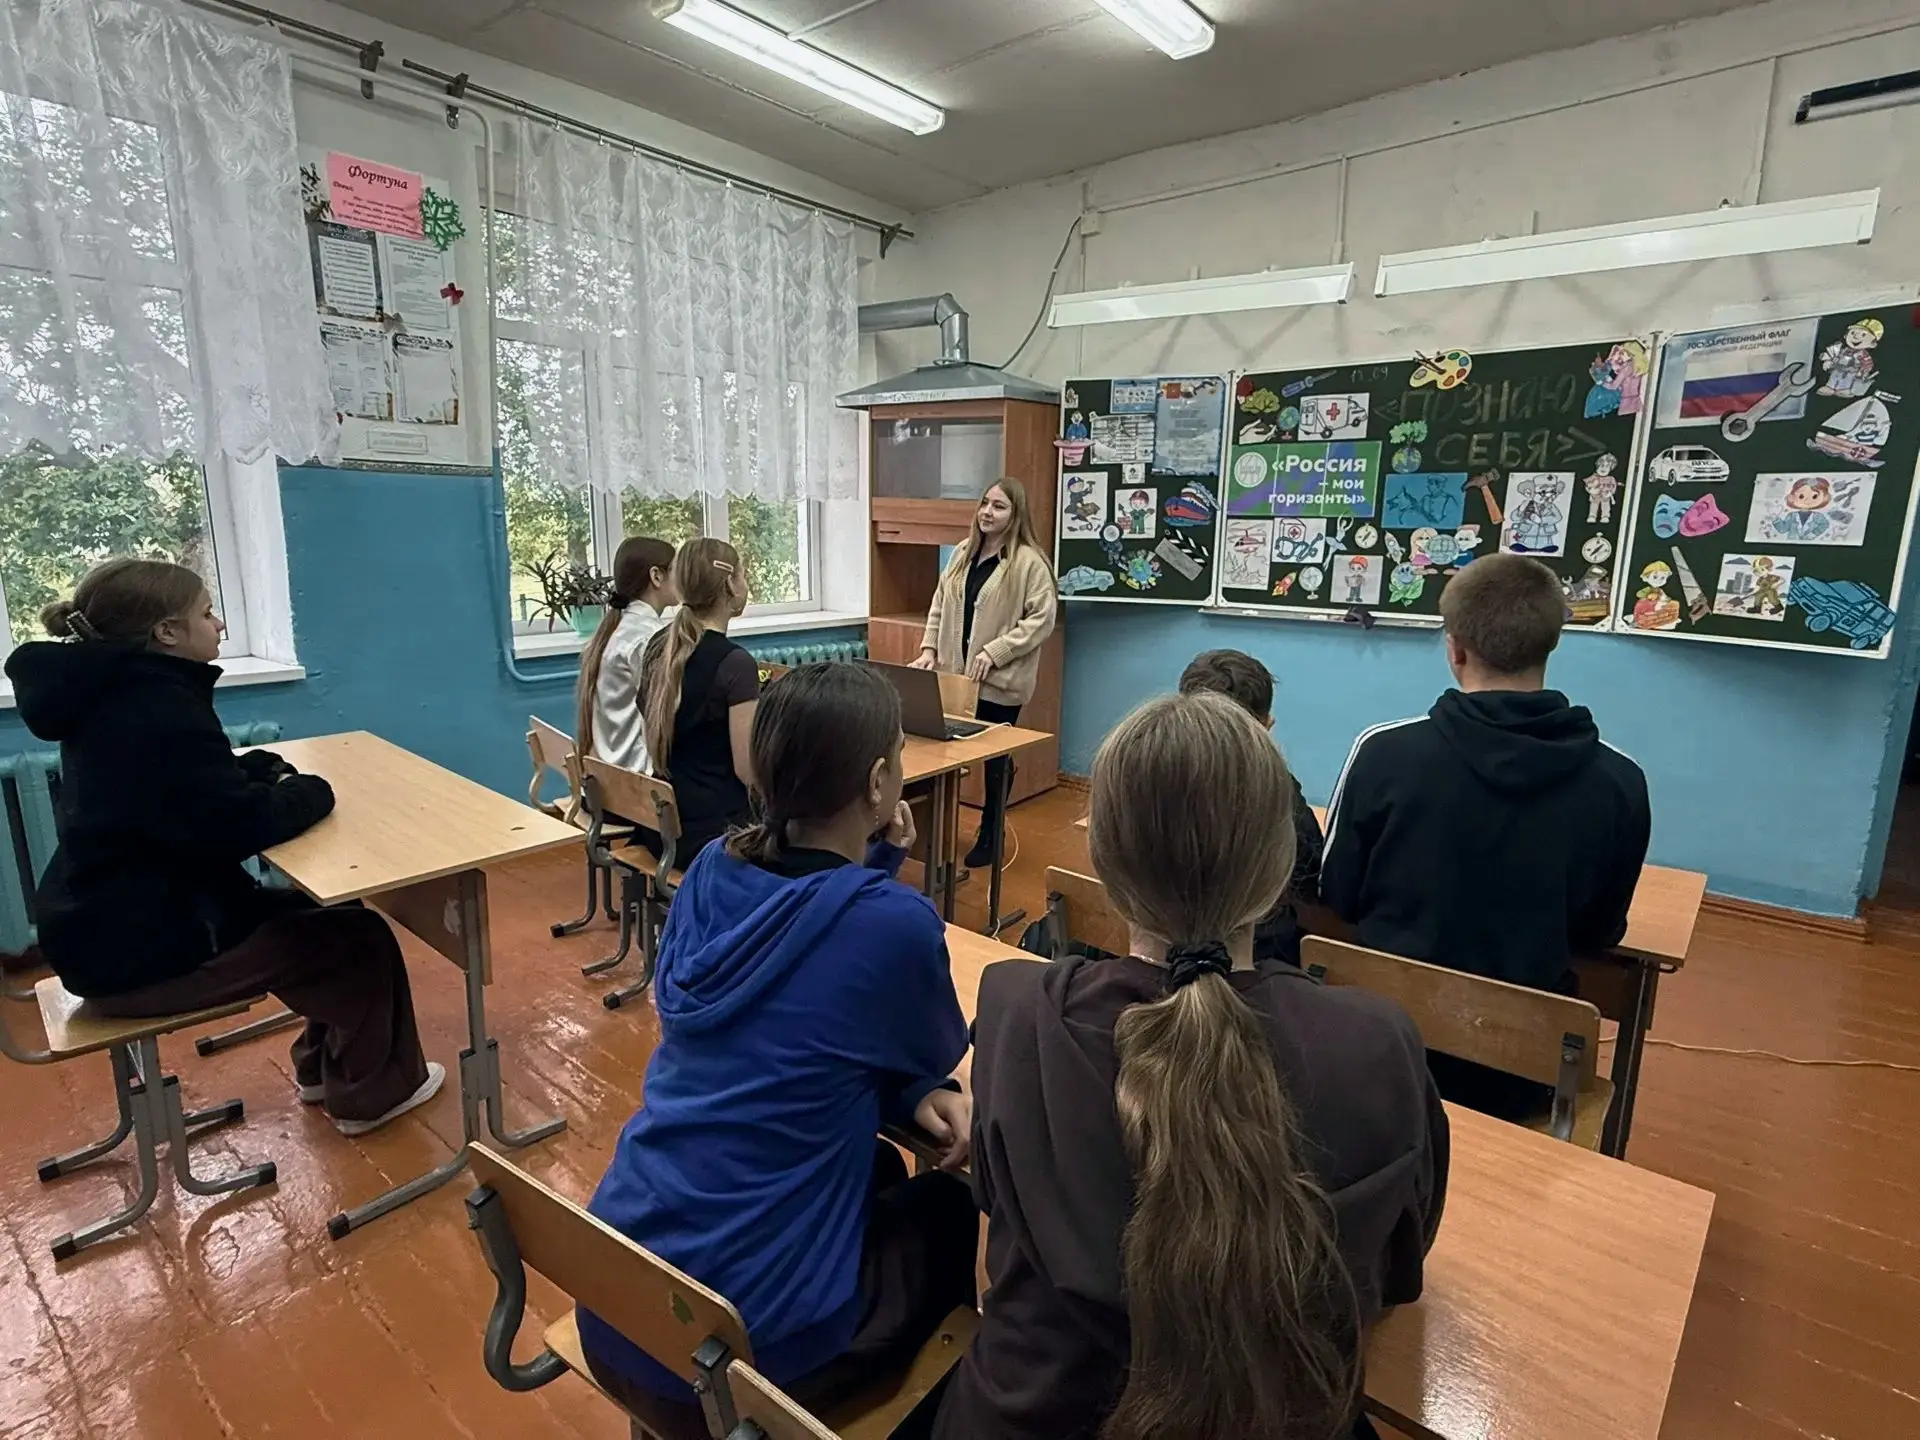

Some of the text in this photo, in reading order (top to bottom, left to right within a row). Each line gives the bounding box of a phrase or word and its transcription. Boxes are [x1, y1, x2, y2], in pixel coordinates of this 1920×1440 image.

[348, 165, 408, 190] Фортуна
[1768, 328, 1791, 340] ФЛАГ
[1271, 454, 1368, 473] «Россия
[1332, 478, 1365, 490] мои
[1268, 492, 1366, 507] горизонты»
